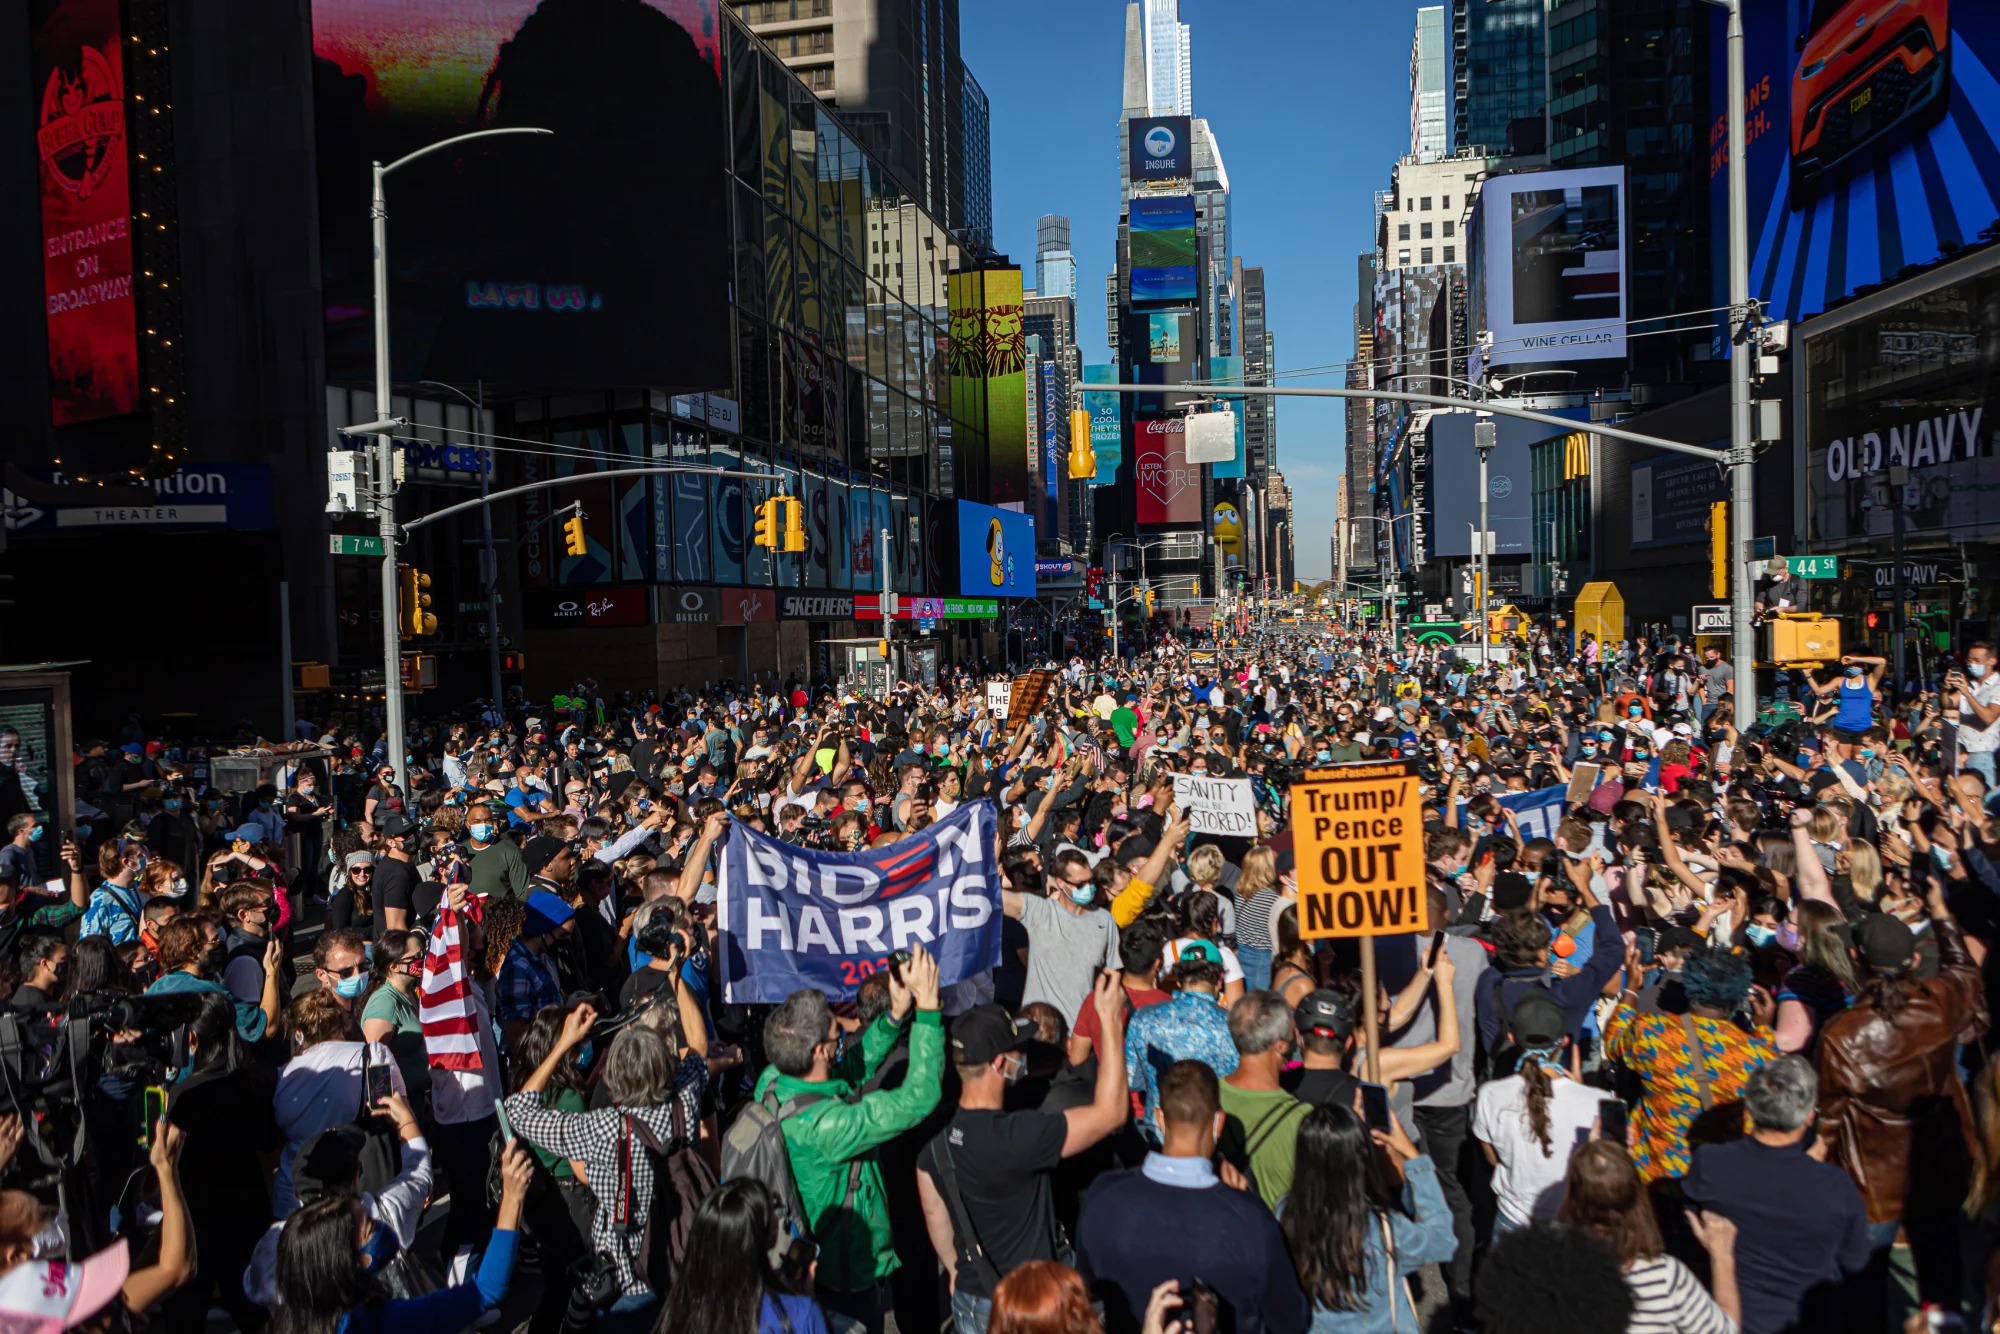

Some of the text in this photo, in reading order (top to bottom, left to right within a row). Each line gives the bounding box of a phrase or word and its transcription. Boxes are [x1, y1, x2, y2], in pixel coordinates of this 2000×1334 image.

[1145, 159, 1175, 169] INSURE
[48, 217, 127, 258] ENTRANCE
[76, 255, 98, 278] ON
[49, 275, 131, 315] BROADWAY
[1523, 333, 1612, 348] WINE CELLAR
[1045, 375, 1055, 431] NOVOTEL
[1827, 407, 1983, 481] OLD NAVY
[95, 509, 177, 520] THEATER
[354, 539, 374, 551] 7 Av
[1797, 558, 1834, 575] 44 St
[587, 597, 614, 617] Ray-Ban
[676, 612, 709, 622] OAKLEY
[782, 596, 853, 616] SKECHERS
[989, 695, 1009, 704] THE
[1304, 765, 1406, 781] RefuseFascism.org
[1176, 777, 1238, 802] SANITY
[1304, 782, 1407, 814] Trump/
[1314, 816, 1403, 842] Pence
[741, 803, 983, 904] BIDEN
[1321, 843, 1402, 885] OUT
[747, 874, 993, 955] HARRIS
[1305, 886, 1419, 932] NOW!
